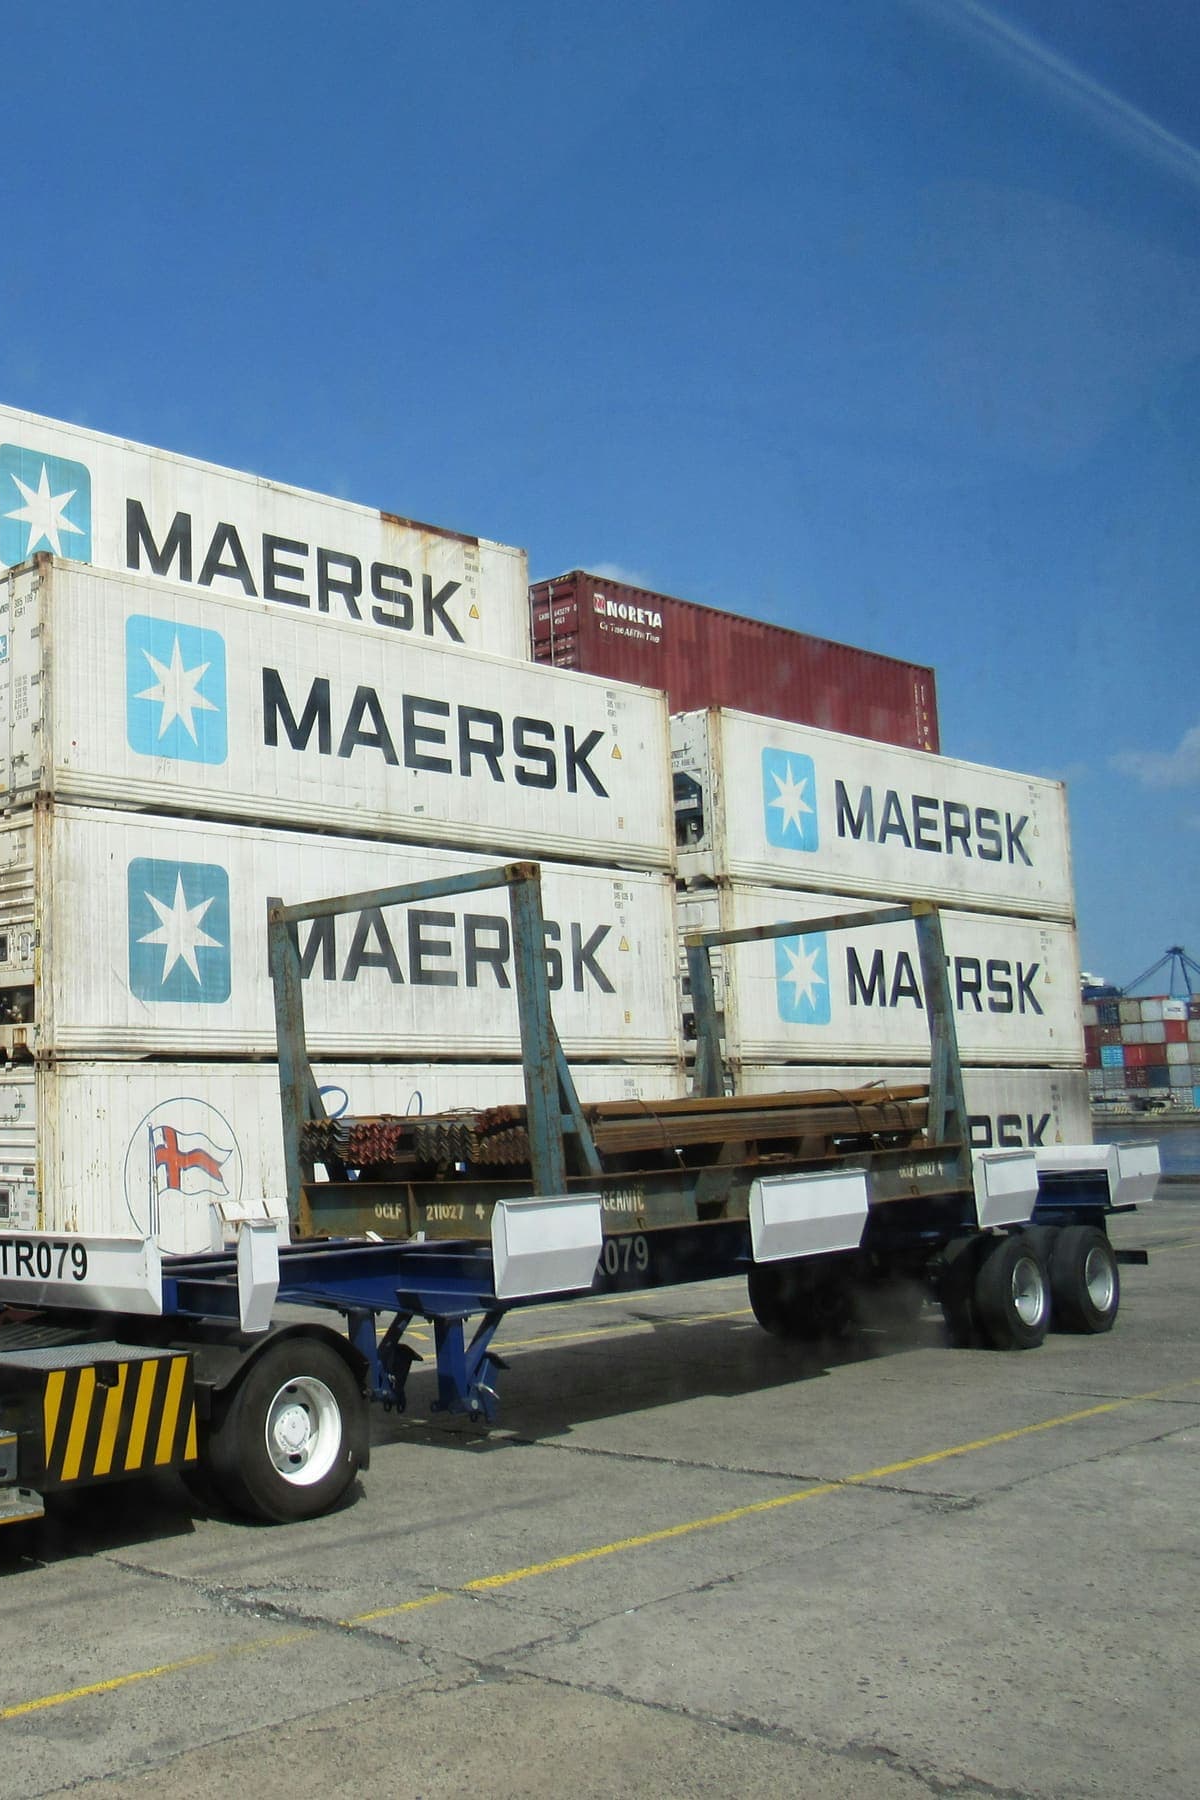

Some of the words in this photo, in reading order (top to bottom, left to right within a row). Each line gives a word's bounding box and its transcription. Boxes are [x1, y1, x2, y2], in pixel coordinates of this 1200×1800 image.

[126, 498, 465, 643] MAERSK
[262, 666, 610, 798] MAERSK
[834, 779, 1034, 867] MAERSK
[846, 946, 1044, 1016] MARSK
[600, 1190, 645, 1212] CEANIC
